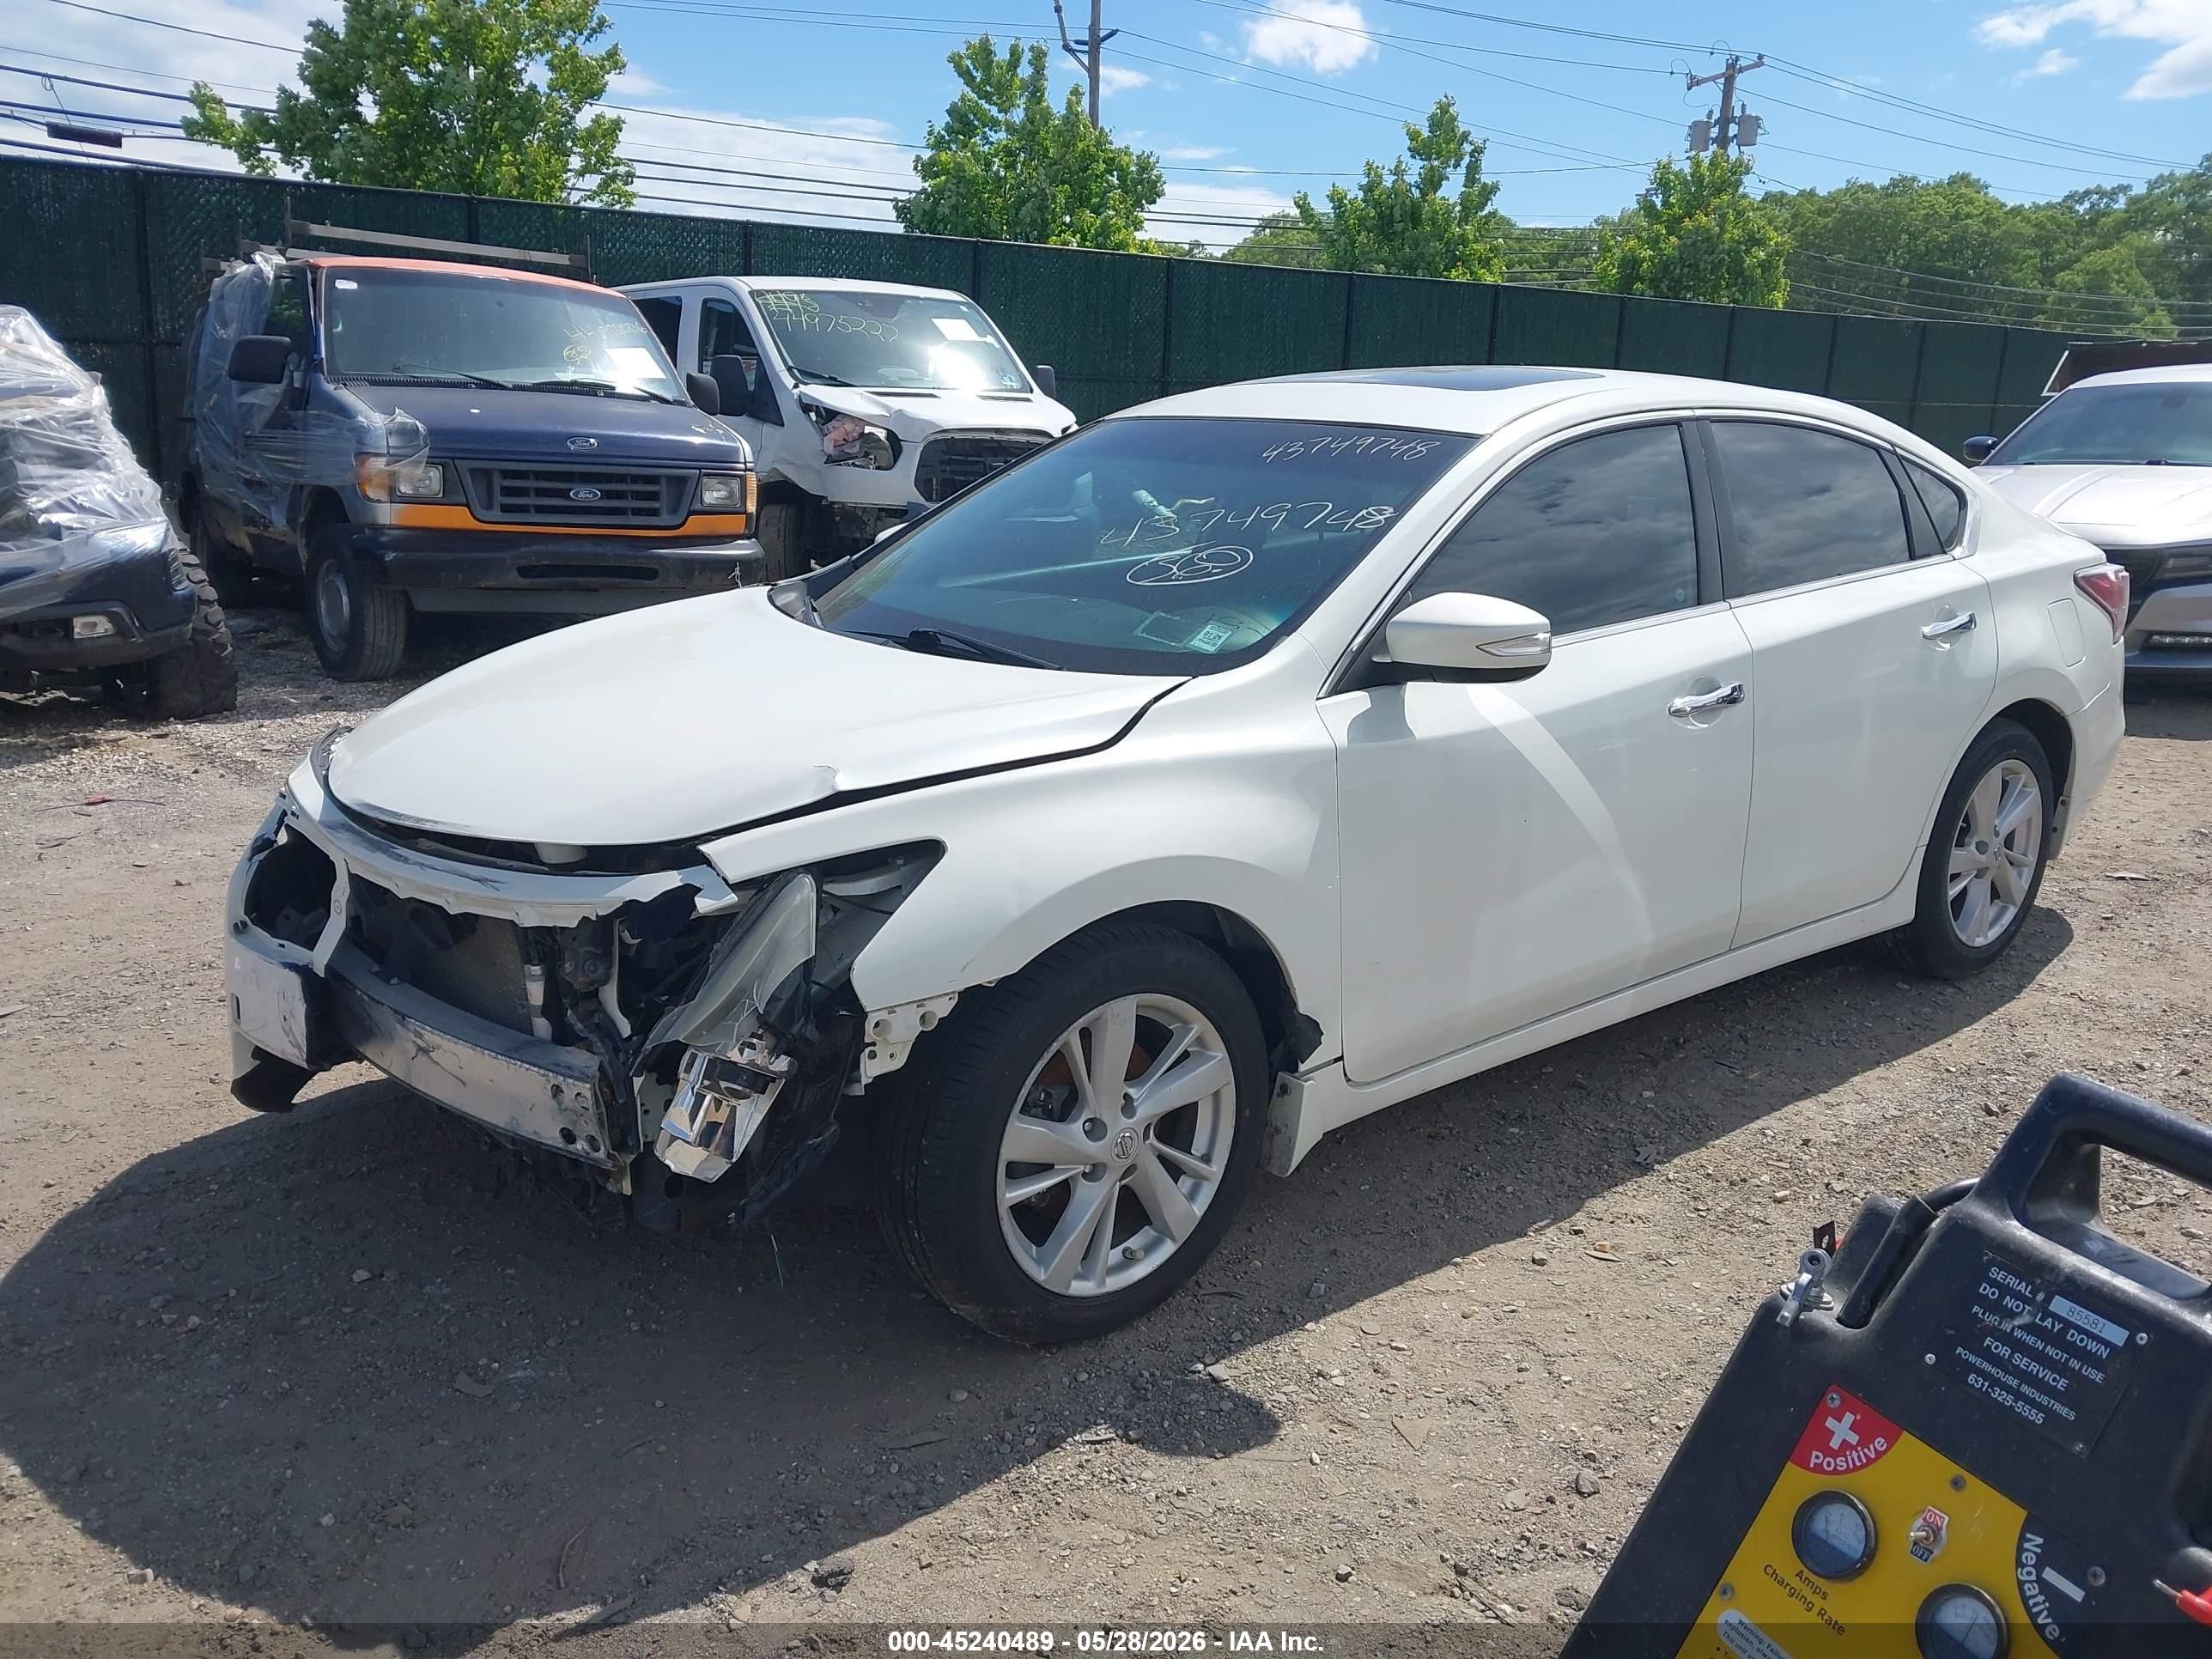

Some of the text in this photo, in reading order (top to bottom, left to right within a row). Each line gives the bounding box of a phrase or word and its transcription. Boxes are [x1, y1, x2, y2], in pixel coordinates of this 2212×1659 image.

[1262, 435, 1442, 464] 43749748
[1978, 1282, 2110, 1359] DO NOT LAY DOWN
[1989, 1267, 2106, 1334] SERIAL # 85581
[1972, 1304, 2106, 1384] PLUG IN WHEN NOT IN USE
[1983, 1336, 2069, 1392] FOR SERVICE
[1955, 1346, 2077, 1421] POWERHOUSE INDUSTRIES
[1966, 1372, 2046, 1425] 631-325-5555
[1809, 1437, 1887, 1472] Positive
[1926, 1511, 1944, 1528] ON
[1912, 1545, 1931, 1561] OFF
[1763, 1564, 1846, 1636] Charging Rate
[1794, 1570, 1829, 1601] Amps
[2017, 1532, 2061, 1641] Negative
